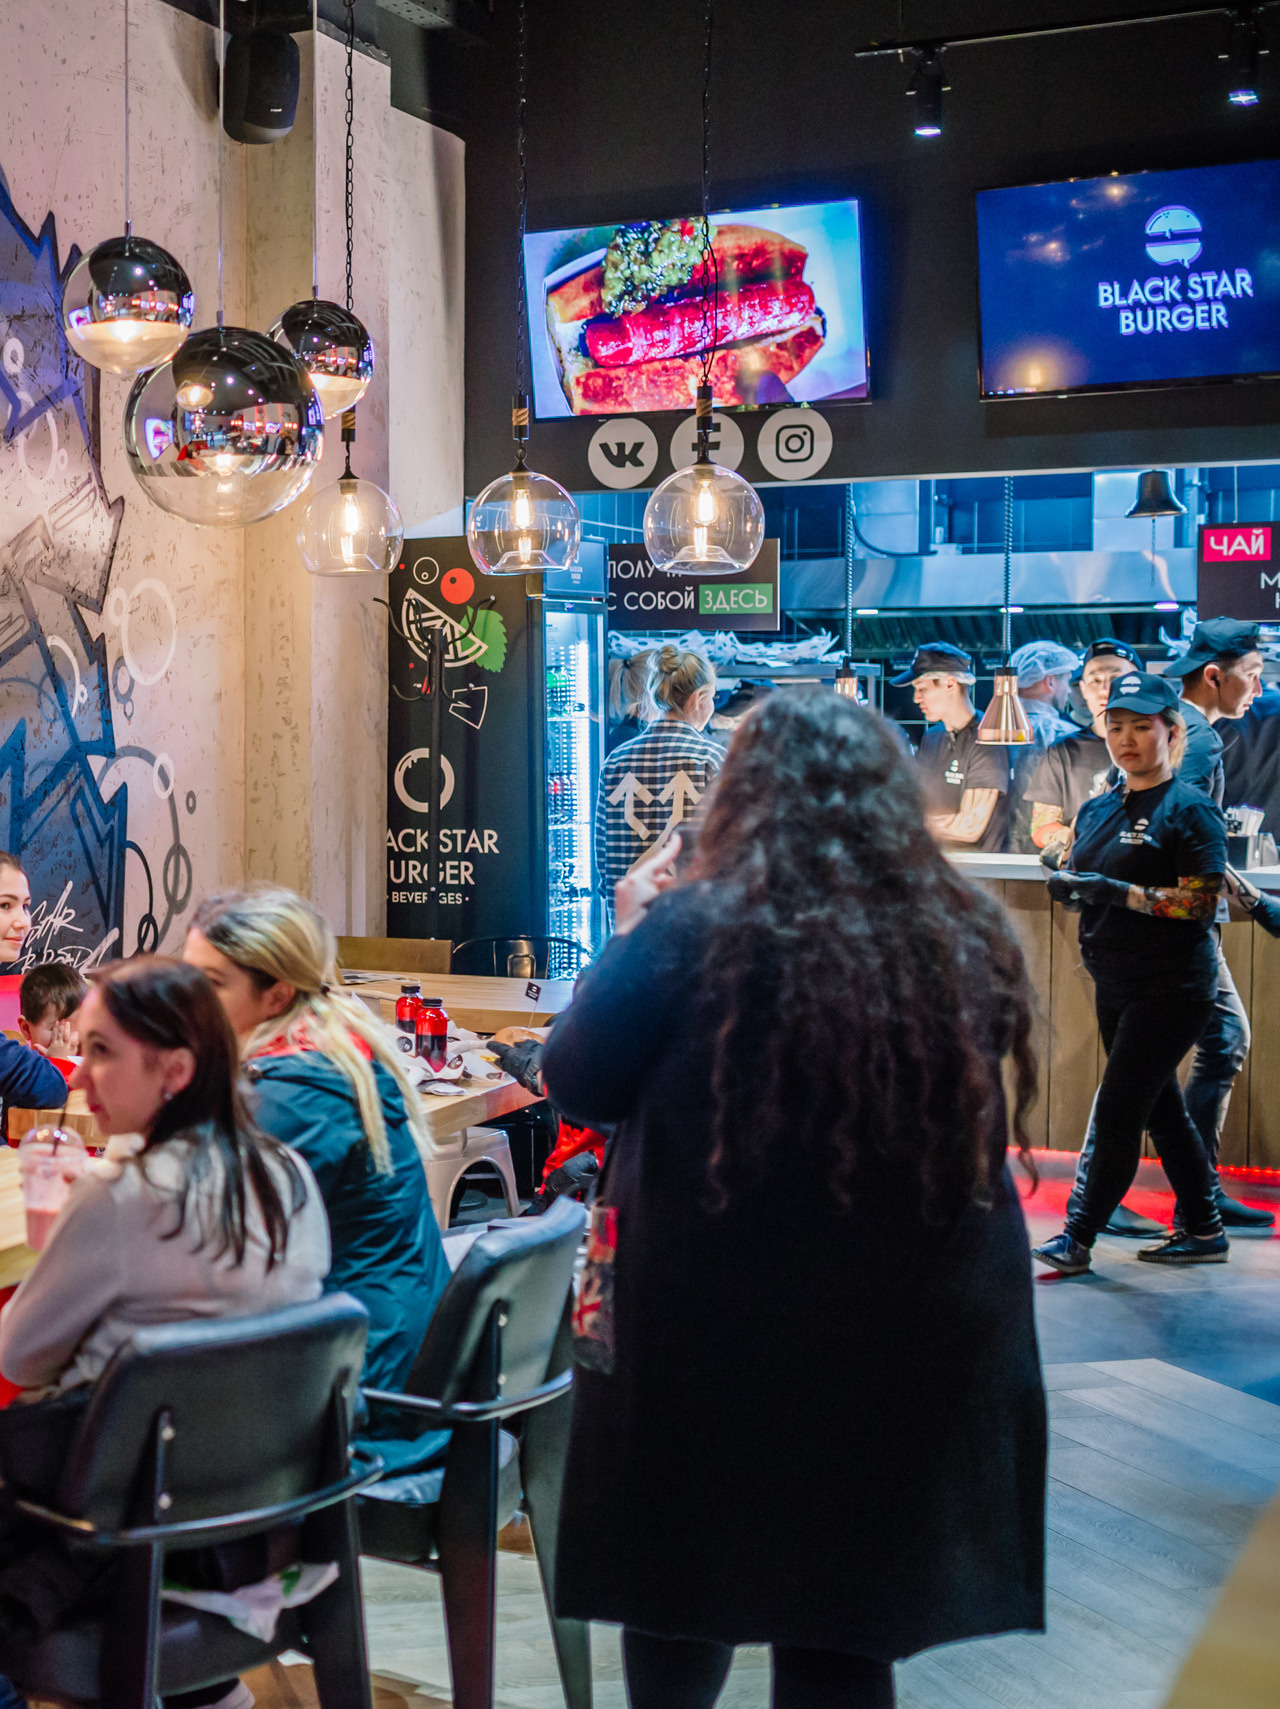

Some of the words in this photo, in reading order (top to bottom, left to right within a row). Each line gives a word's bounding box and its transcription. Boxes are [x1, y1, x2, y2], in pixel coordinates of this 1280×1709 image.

[1098, 276, 1183, 308] BLACK
[1187, 267, 1254, 301] STAR
[1120, 300, 1229, 336] BURGER
[1209, 528, 1265, 556] ЧАЙ
[607, 560, 682, 578] ПОЛУ
[623, 585, 695, 611] СОБОЙ
[704, 589, 768, 612] ЗДЕСЬ
[439, 828, 500, 854] STAR
